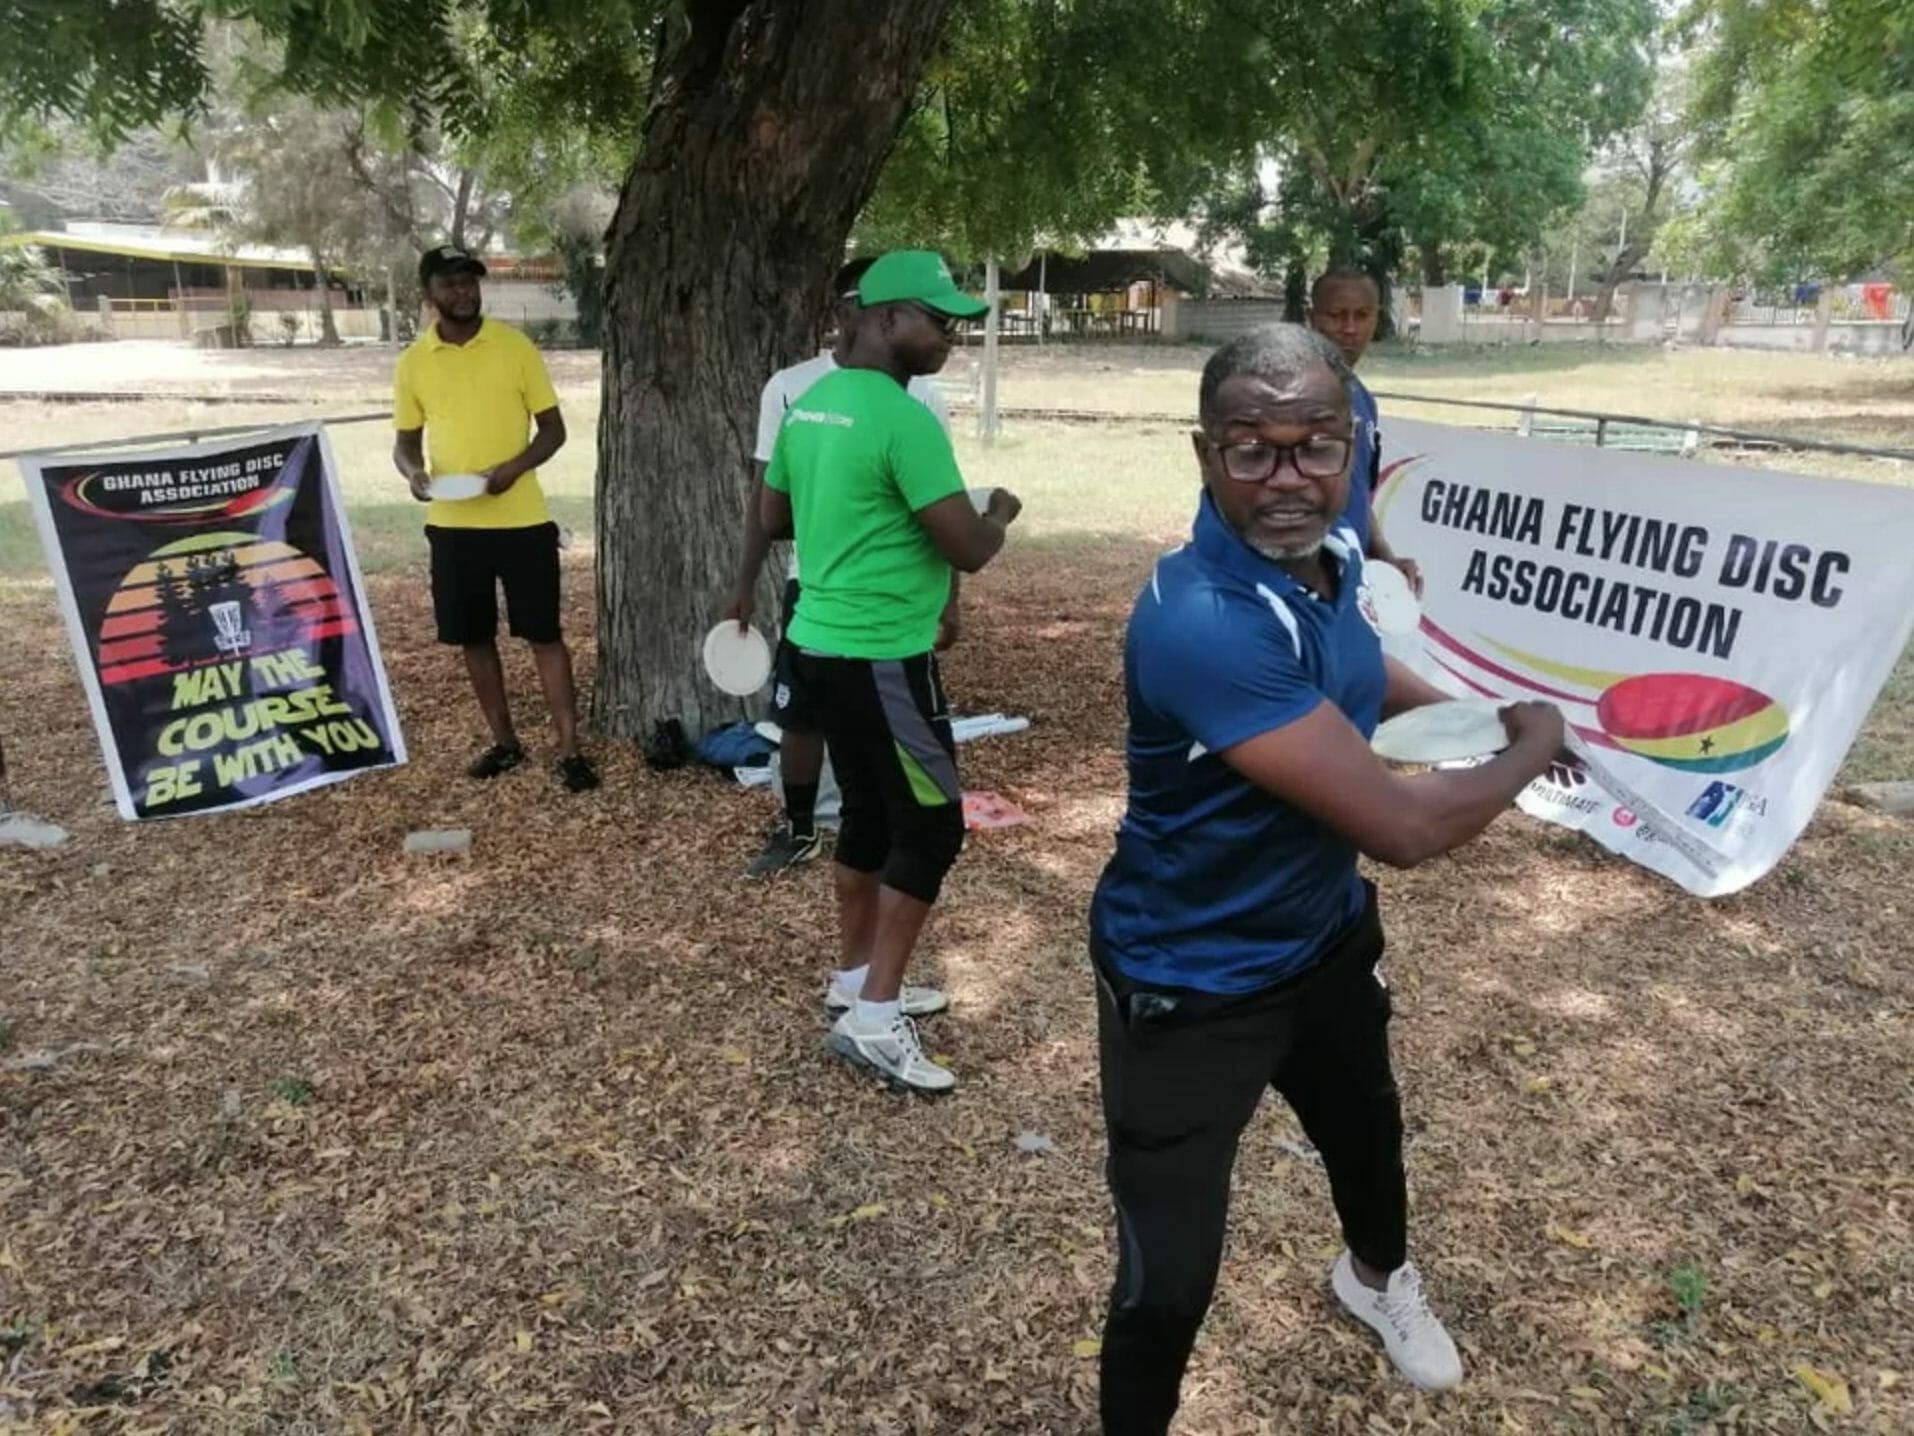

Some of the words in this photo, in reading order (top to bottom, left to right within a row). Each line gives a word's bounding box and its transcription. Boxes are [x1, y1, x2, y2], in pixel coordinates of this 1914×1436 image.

[103, 470, 174, 491] GHANA
[180, 462, 241, 484] FLYING
[246, 453, 284, 473] DISC
[140, 475, 260, 504] ASSOCIATION
[1420, 479, 1545, 545] GHANA
[1555, 503, 1709, 579] FLYING
[1717, 533, 1850, 609] DISC
[1461, 548, 1743, 659] ASSOCIATION
[171, 661, 243, 711] MAY
[251, 648, 326, 688] THE
[157, 684, 352, 757] COURSE
[145, 759, 203, 807] BE
[213, 733, 304, 788] WITH
[302, 718, 380, 754] YOU
